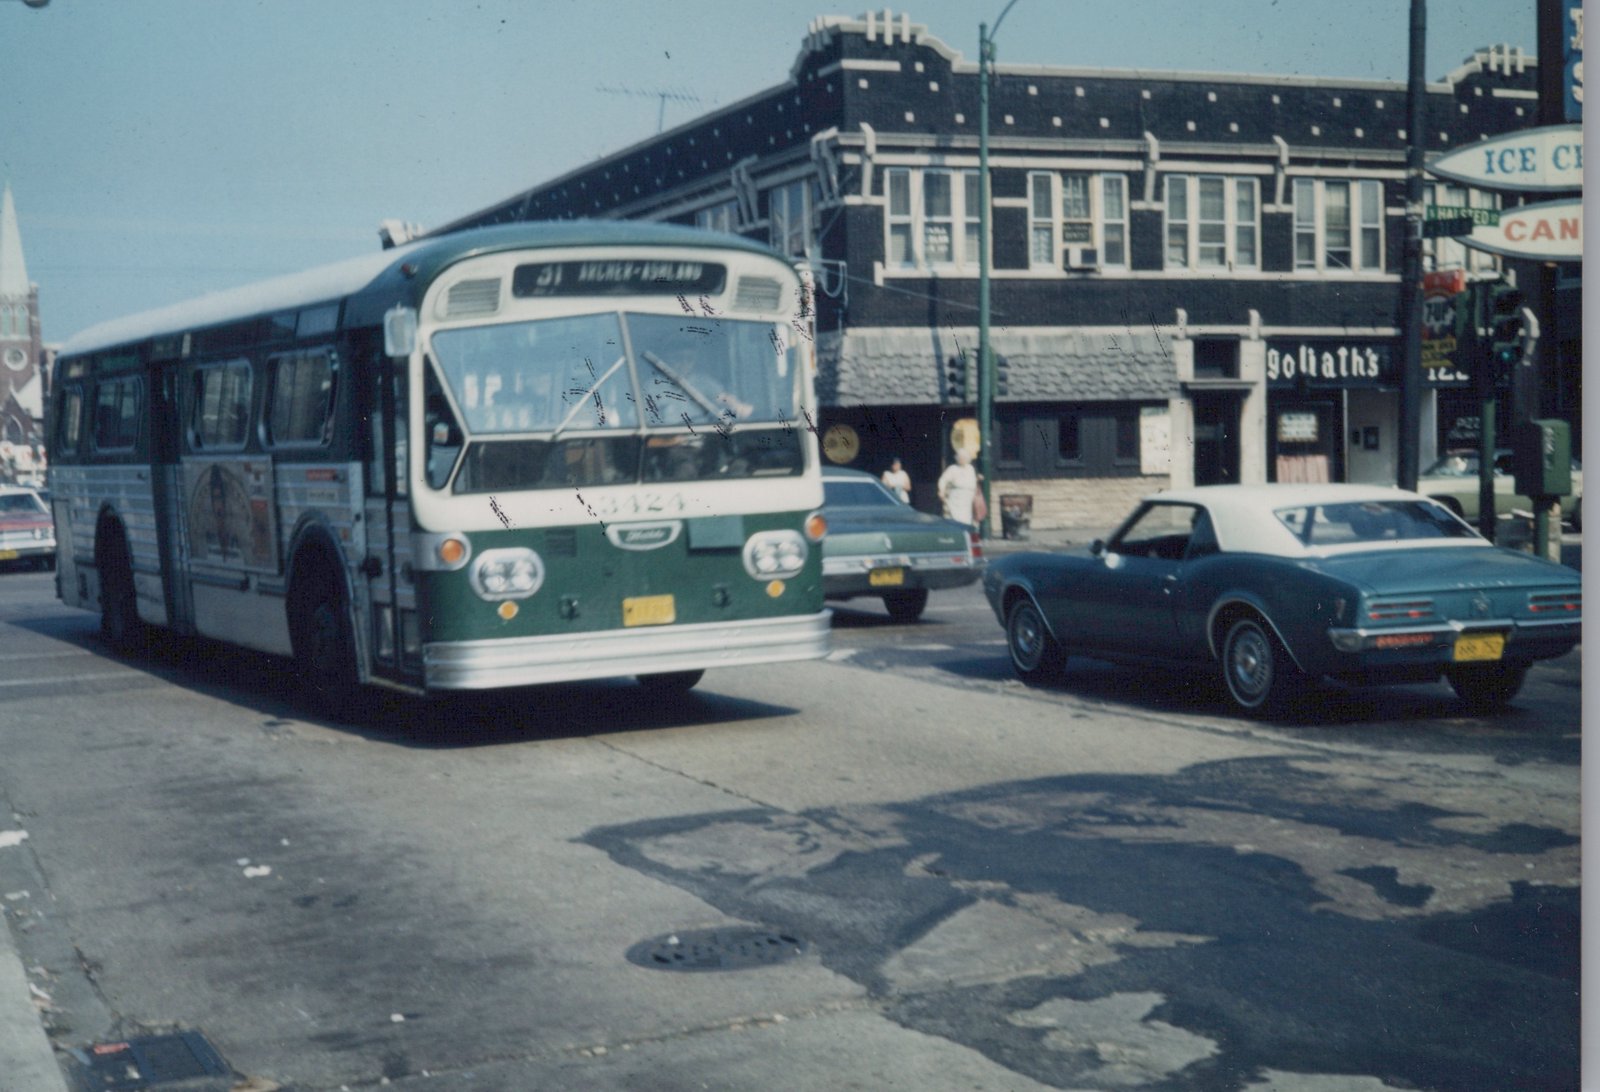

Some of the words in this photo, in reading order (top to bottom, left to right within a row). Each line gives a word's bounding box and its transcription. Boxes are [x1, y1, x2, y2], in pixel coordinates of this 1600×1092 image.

[1485, 147, 1536, 174] ICE
[1504, 217, 1580, 242] CAN
[1267, 344, 1379, 380] goliath's
